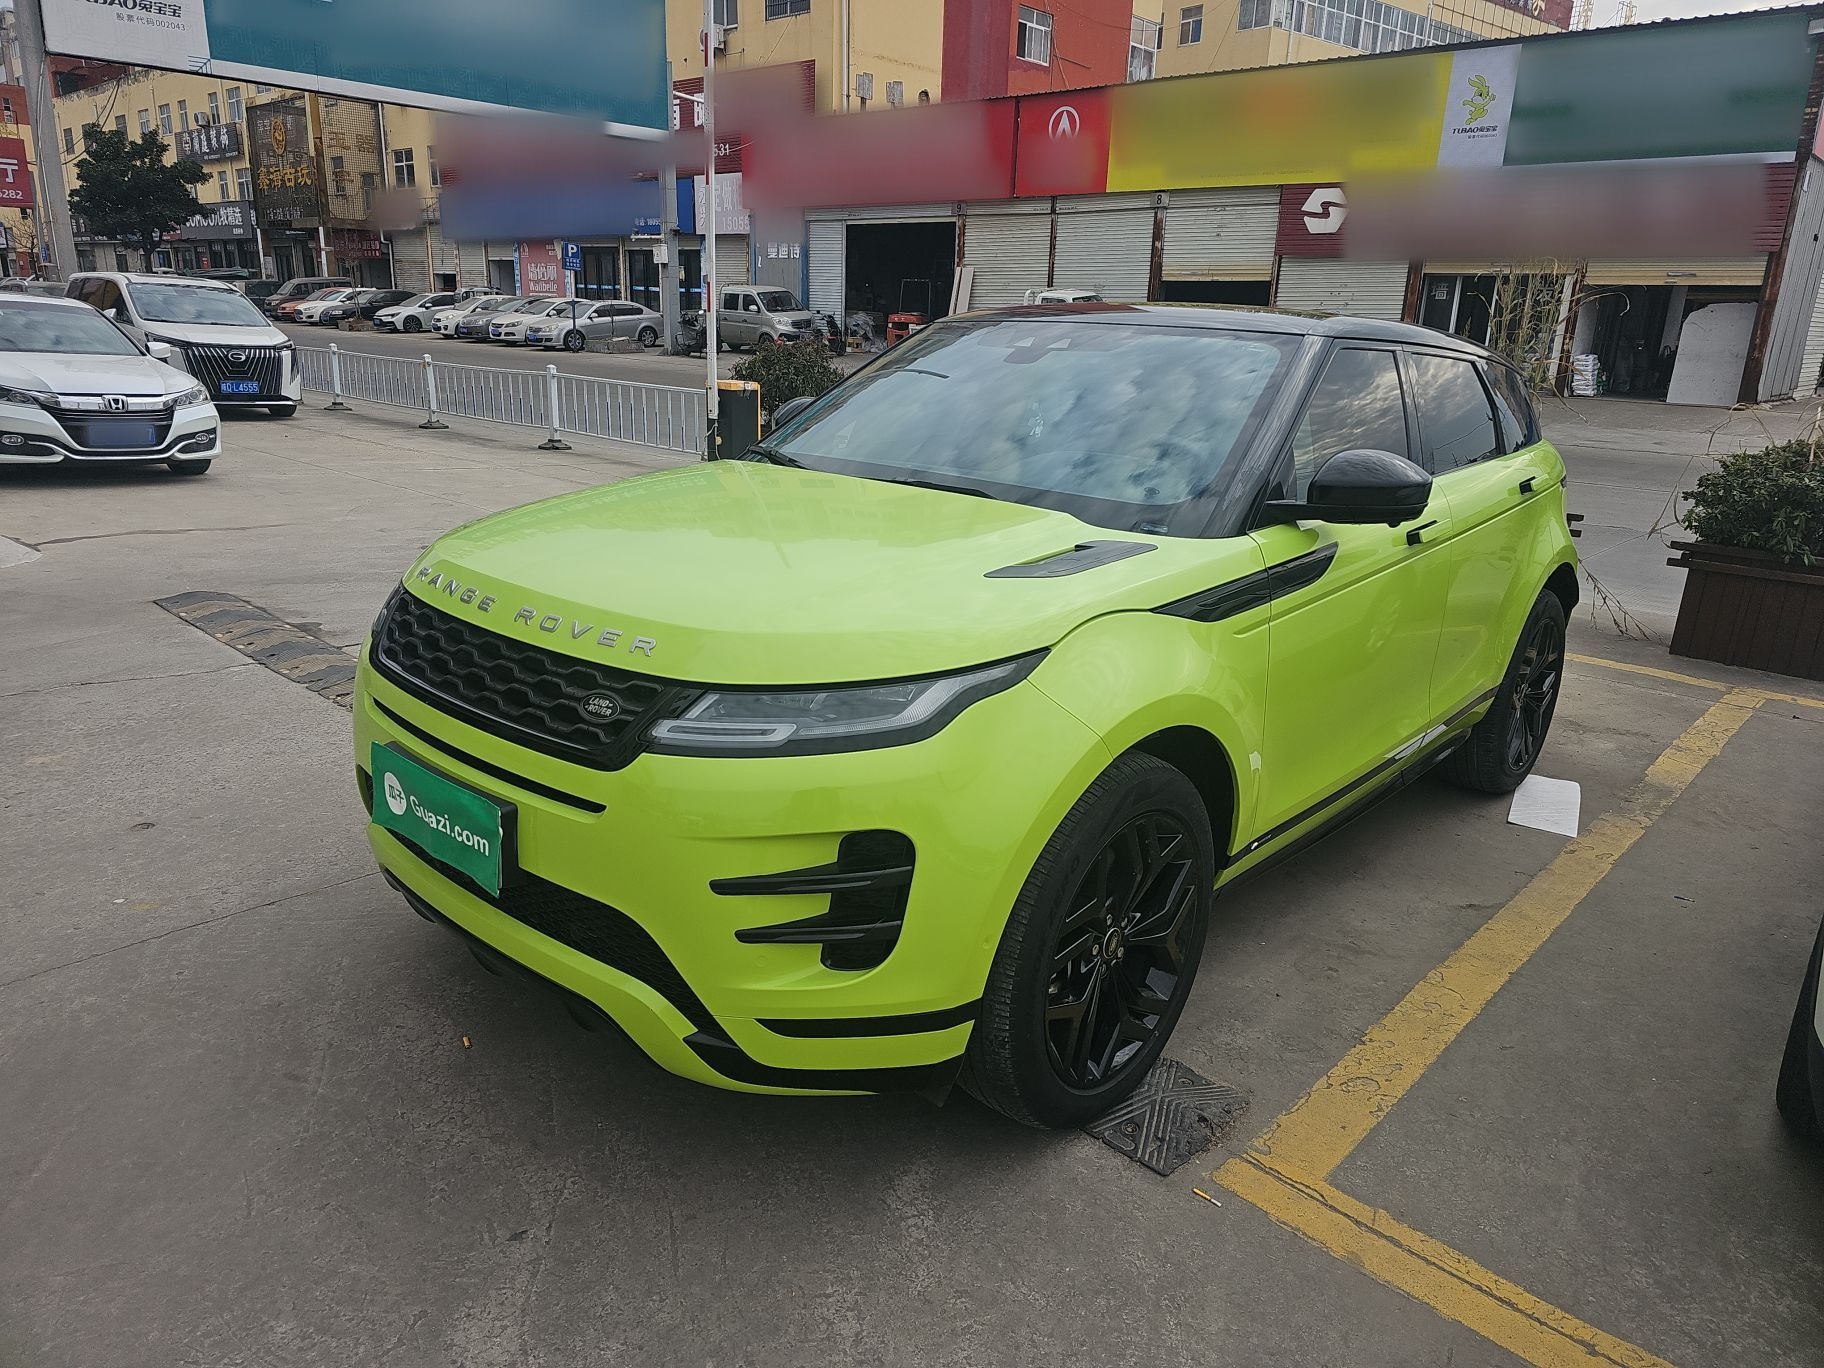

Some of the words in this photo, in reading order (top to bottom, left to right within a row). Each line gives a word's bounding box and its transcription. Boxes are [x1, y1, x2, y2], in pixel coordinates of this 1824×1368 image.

[1156, 194, 1163, 206] 8
[956, 203, 963, 215] 9
[568, 244, 577, 257] P
[416, 566, 496, 612] RANGE
[514, 606, 657, 657] ROVER
[589, 697, 610, 707] LAND
[587, 704, 612, 717] ROVER
[409, 795, 489, 856] Guazi.com
